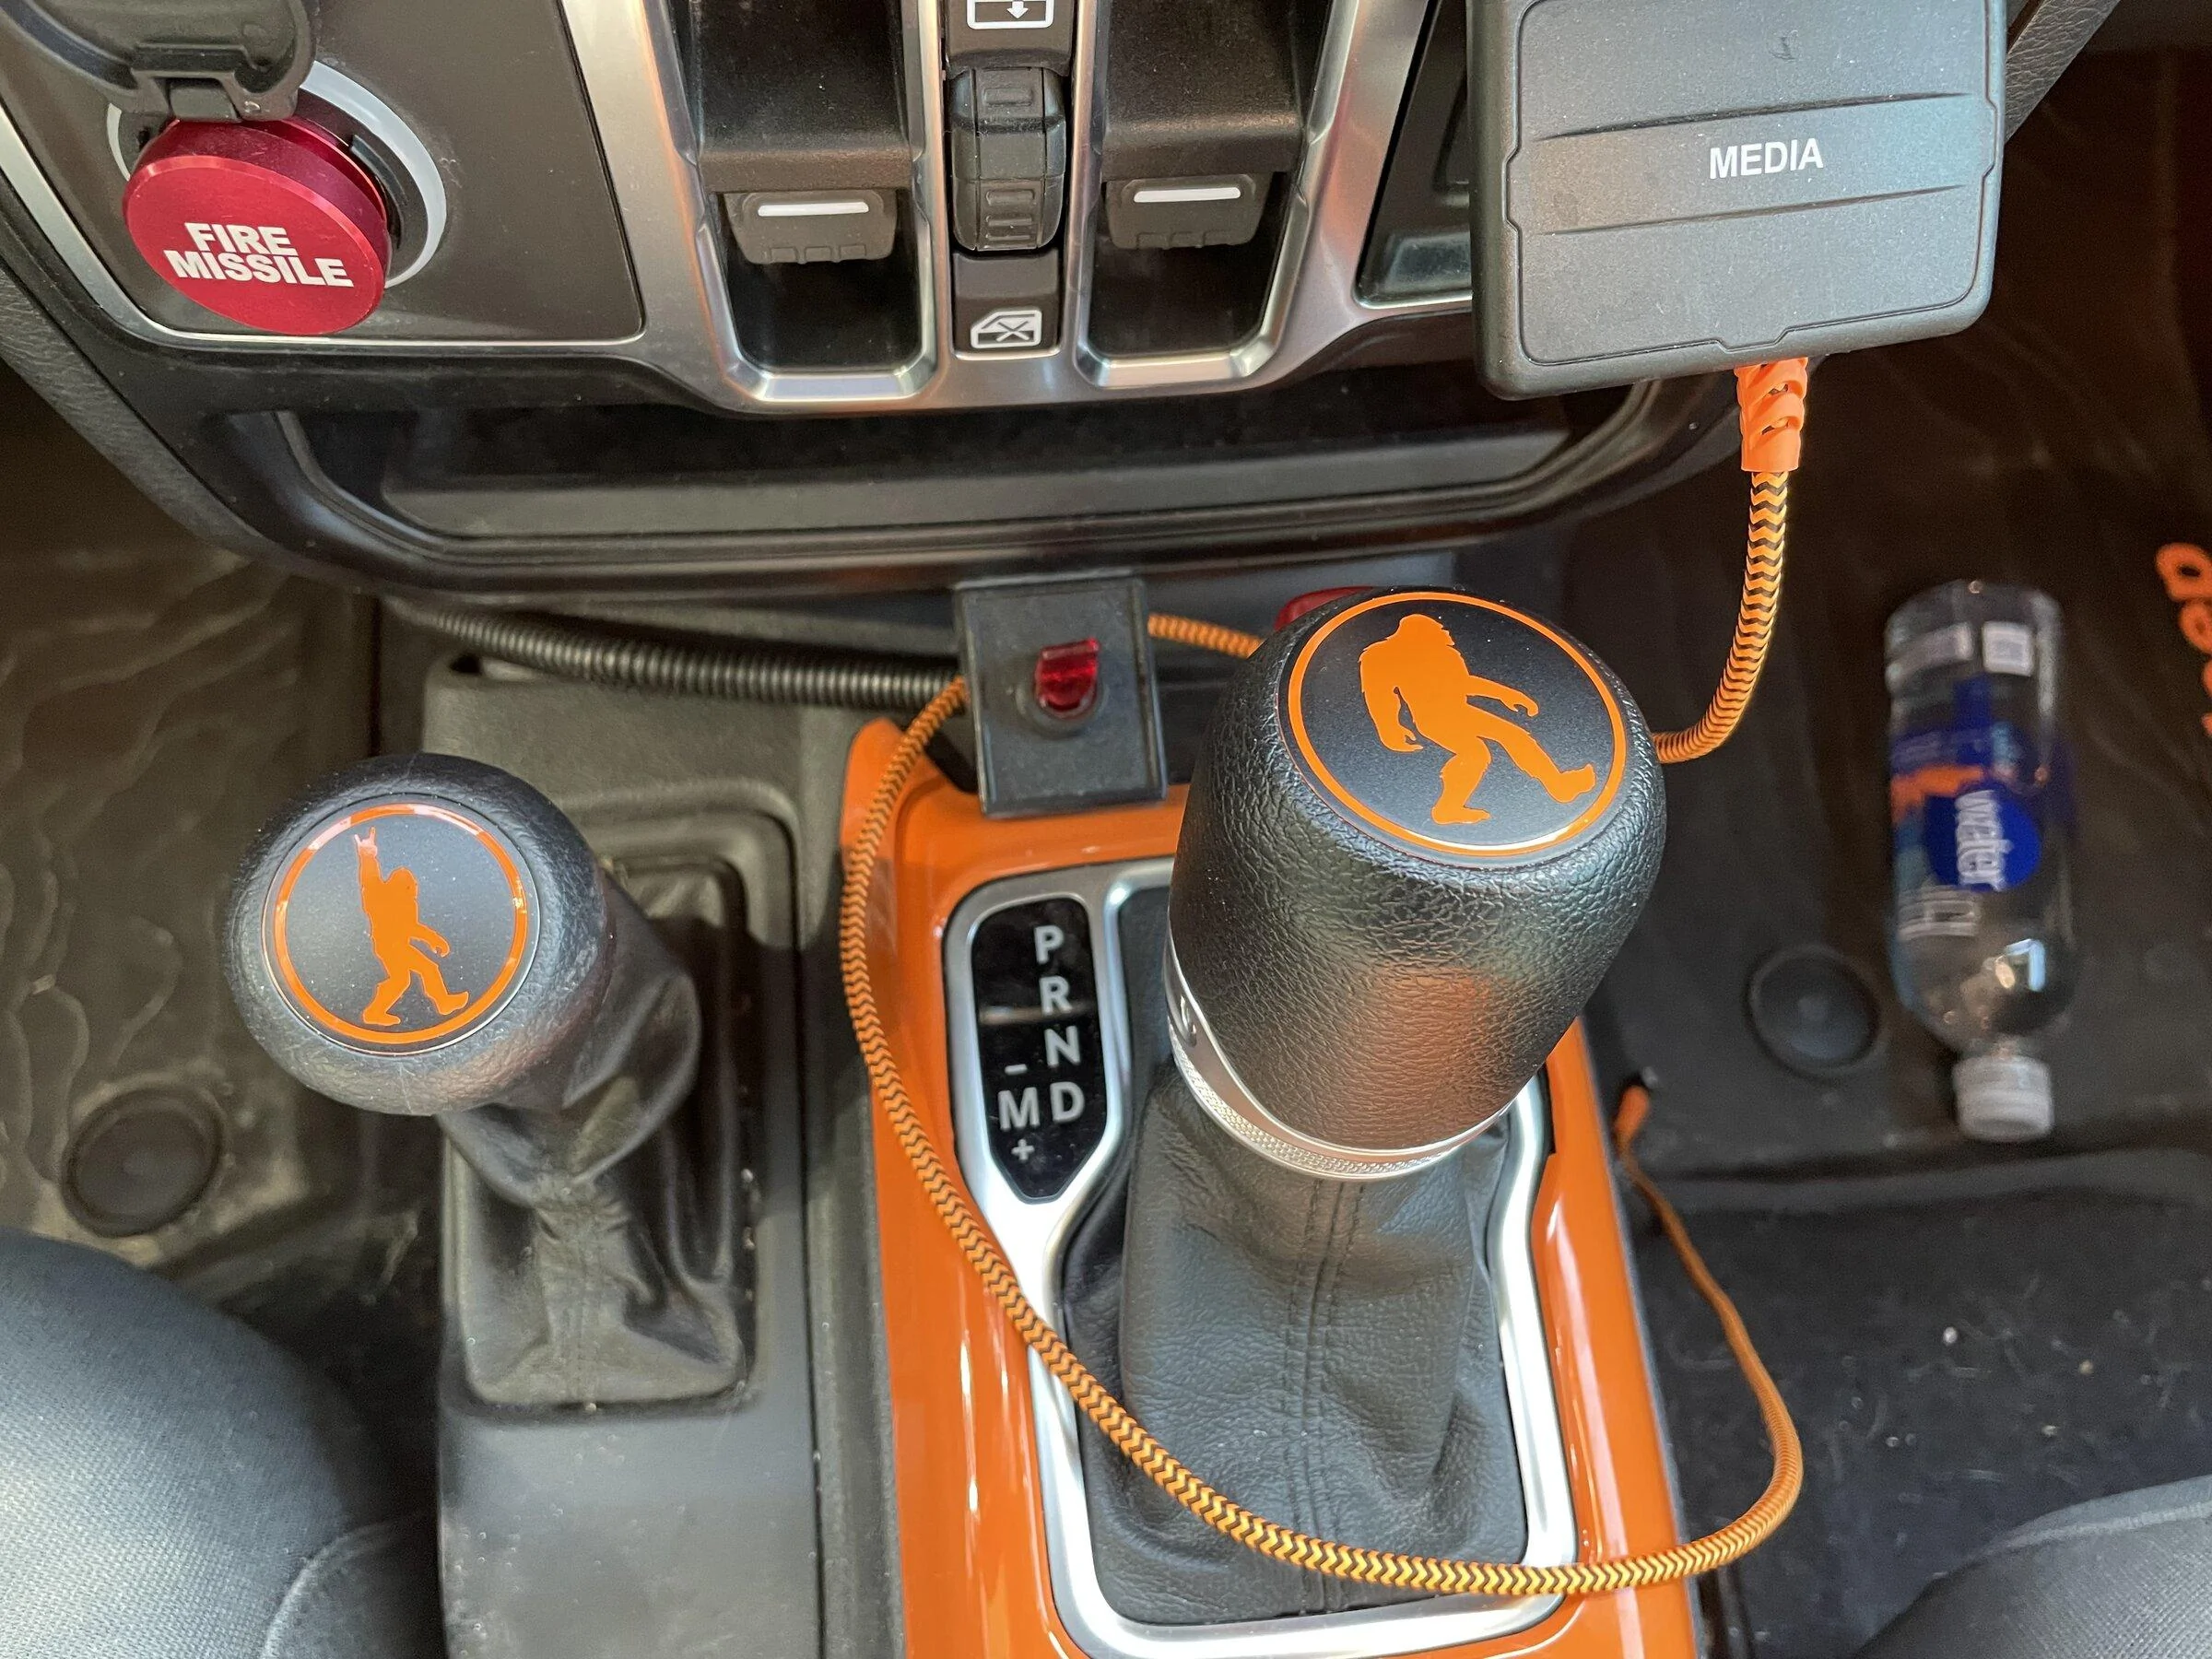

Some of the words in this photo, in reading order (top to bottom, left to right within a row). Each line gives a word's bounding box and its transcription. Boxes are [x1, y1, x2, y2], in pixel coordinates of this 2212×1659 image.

[1709, 137, 1824, 180] MEDIA
[184, 222, 299, 256] FIRE
[163, 250, 355, 288] MISSILE
[1033, 924, 1065, 964] P
[1038, 975, 1073, 1015] R
[1044, 1025, 1081, 1068] N
[997, 1086, 1041, 1131] M
[1049, 1080, 1086, 1124] D
